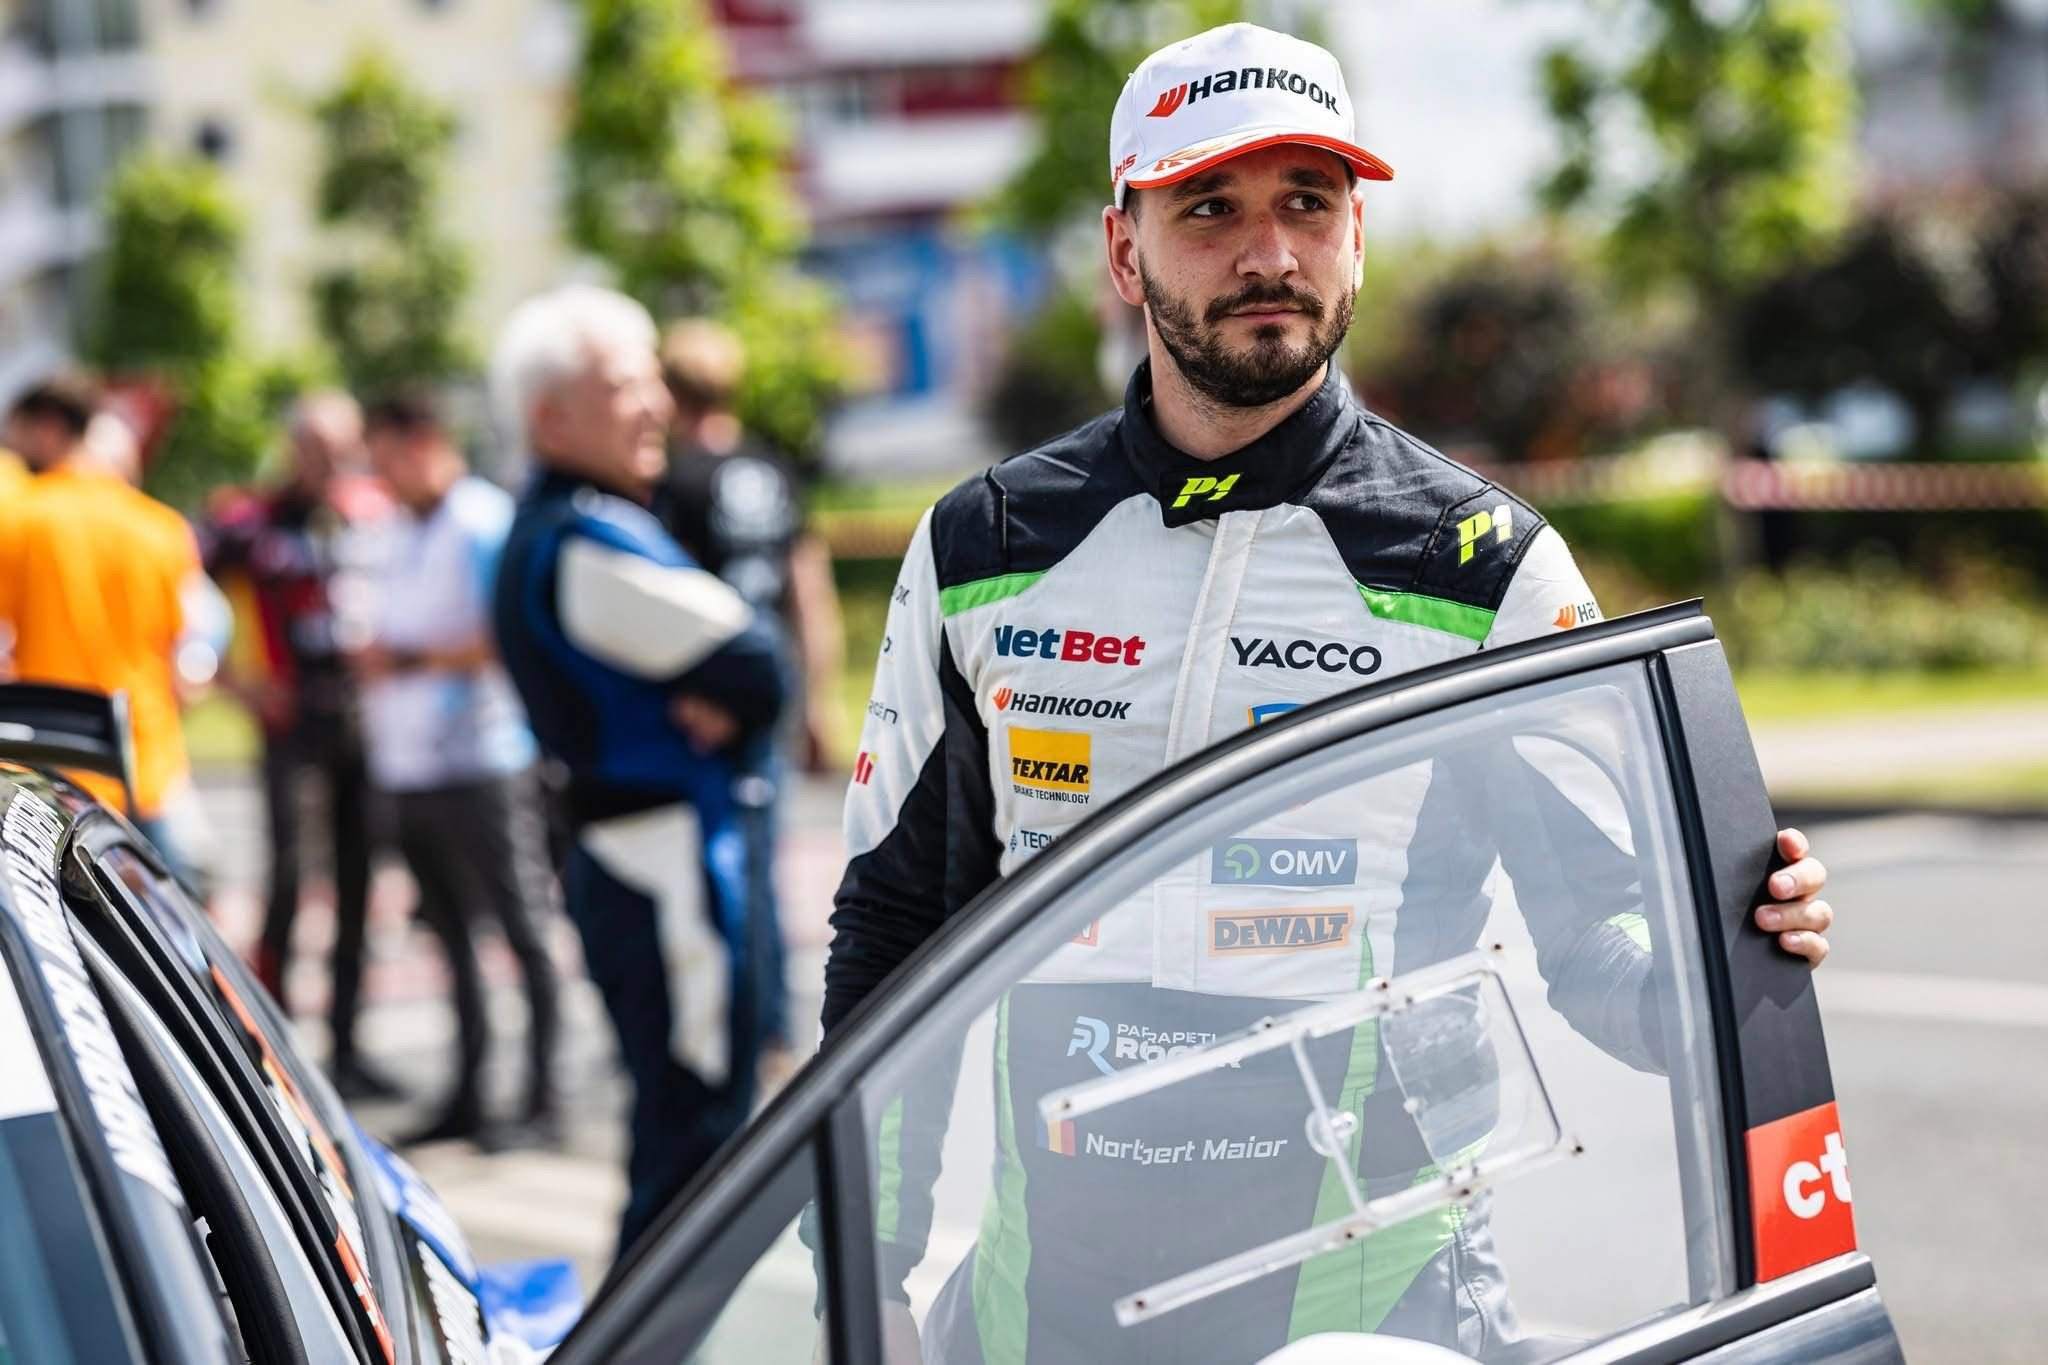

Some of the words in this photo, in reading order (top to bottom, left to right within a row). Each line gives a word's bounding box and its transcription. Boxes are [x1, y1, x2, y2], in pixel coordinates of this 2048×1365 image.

[1171, 473, 1241, 508] P1
[1456, 504, 1513, 565] P1
[994, 624, 1146, 666] NetBet
[1230, 636, 1382, 676] YACCO
[1012, 757, 1089, 784] TEXTAR
[1013, 784, 1034, 798] BRAKE
[1035, 789, 1090, 804] TECHNOLOGY
[1269, 849, 1347, 875] OMV
[1085, 1132, 1195, 1165] Norbert
[1202, 1135, 1289, 1161] Maior
